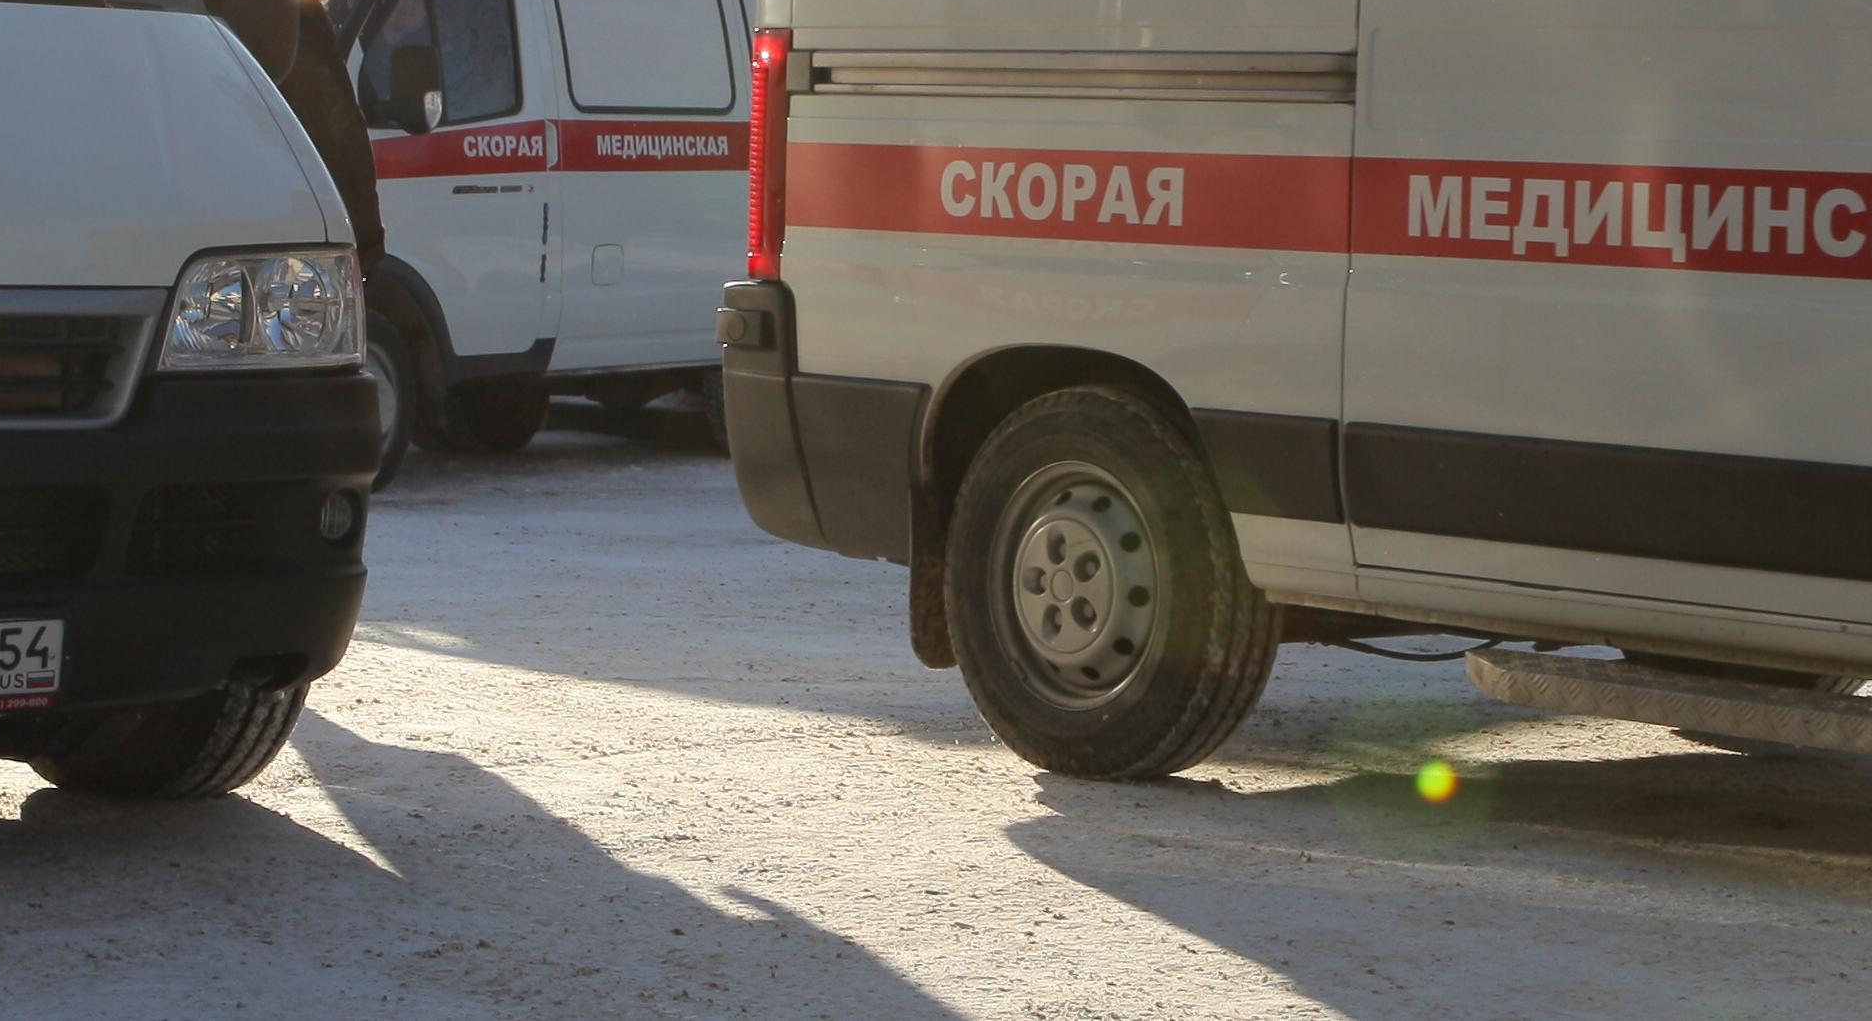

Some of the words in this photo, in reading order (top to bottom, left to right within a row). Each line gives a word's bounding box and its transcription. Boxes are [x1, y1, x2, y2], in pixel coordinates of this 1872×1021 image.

[463, 135, 543, 157] СКОРАЯ
[597, 134, 729, 159] МЕДИЦИНСКАЯ
[940, 160, 1184, 226] СКОРАЯ
